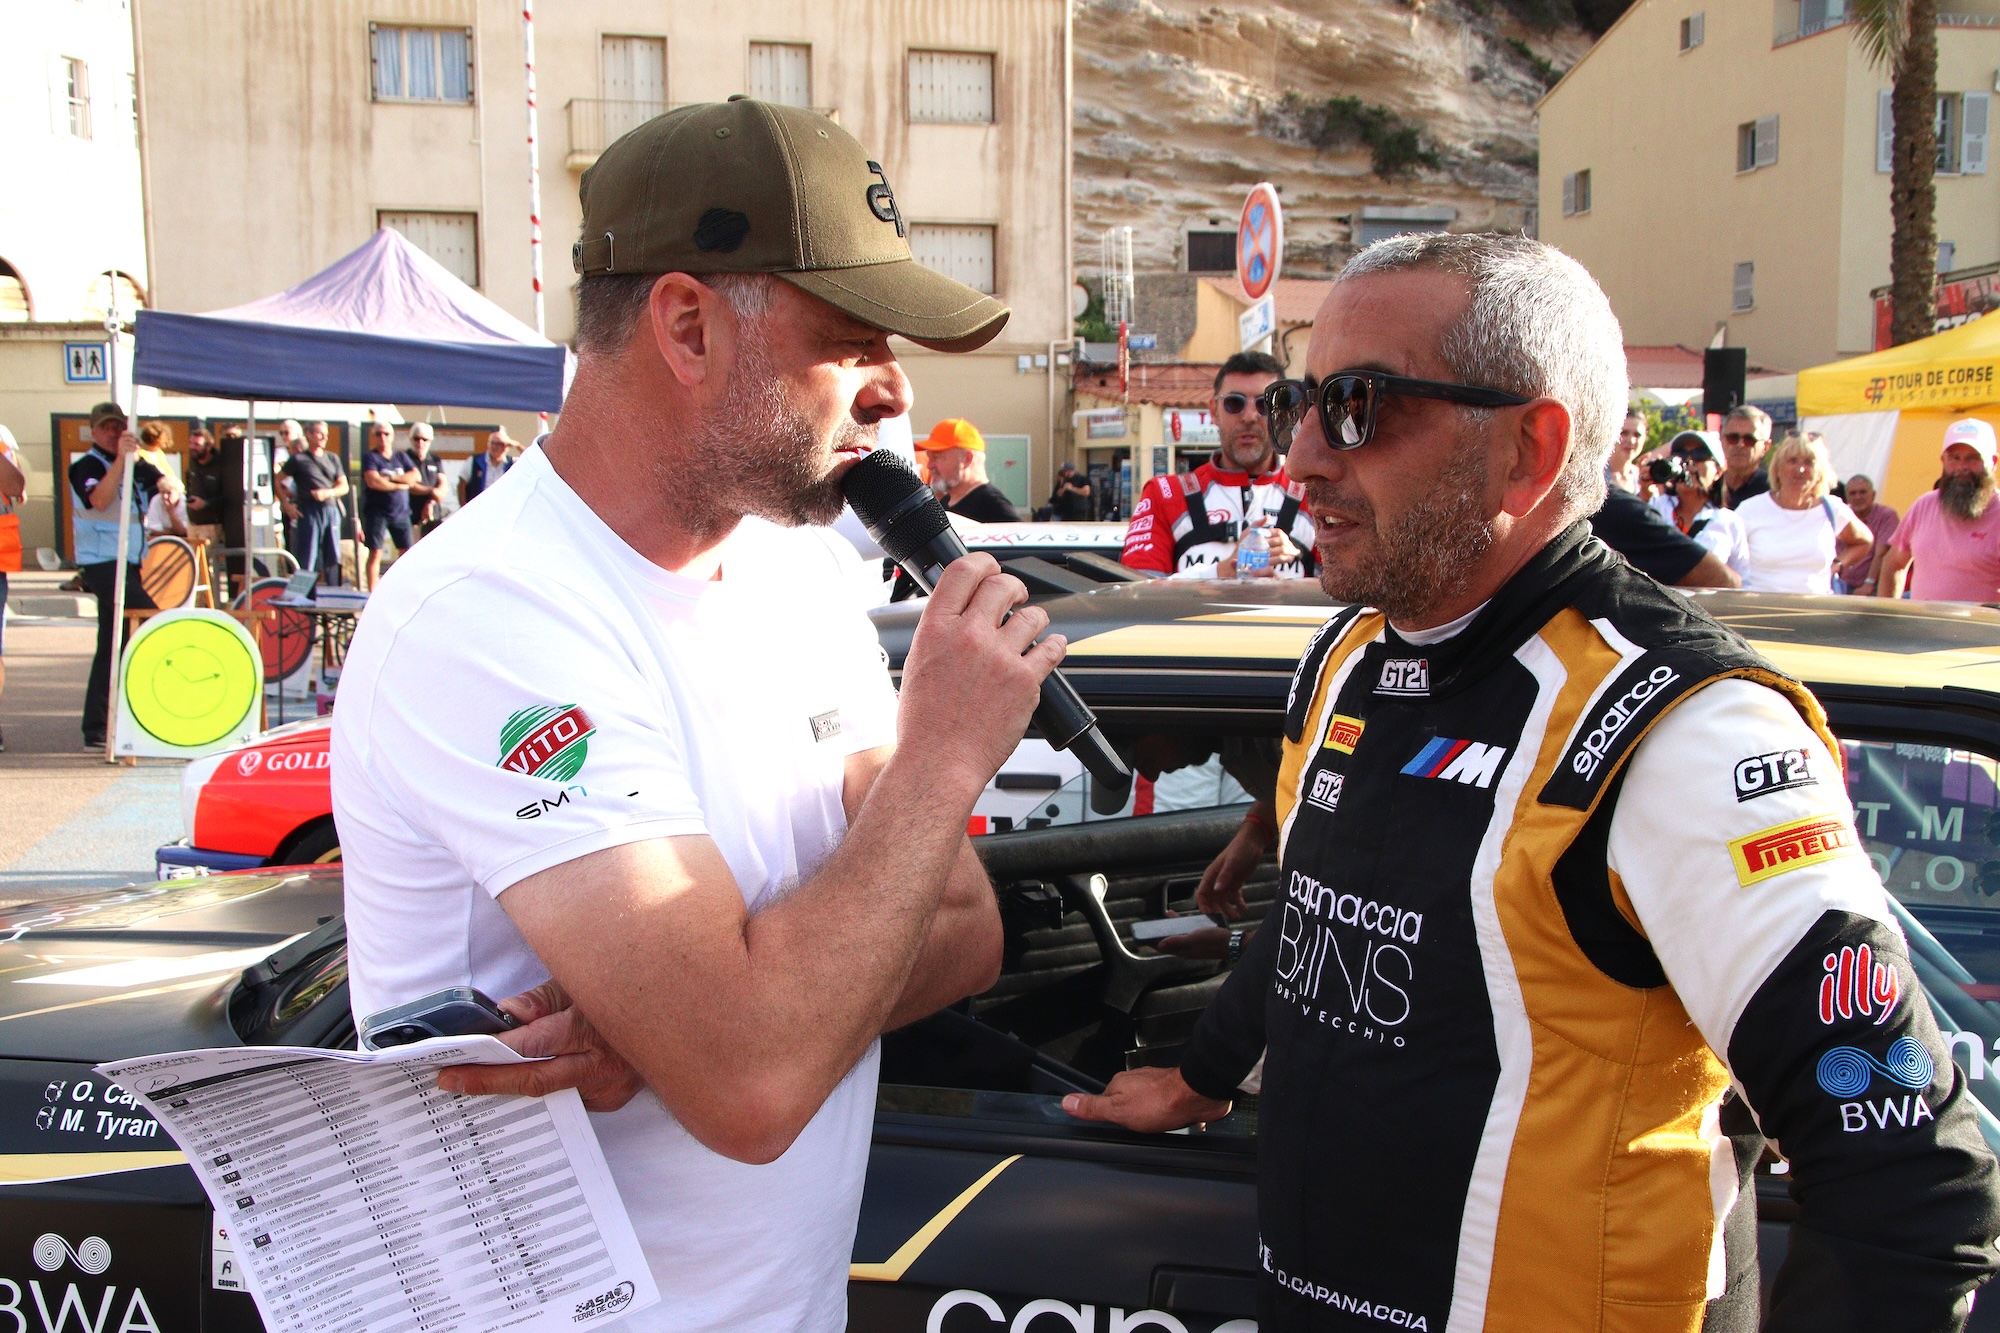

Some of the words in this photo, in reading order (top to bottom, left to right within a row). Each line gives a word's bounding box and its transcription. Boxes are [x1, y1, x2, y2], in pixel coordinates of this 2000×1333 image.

[1888, 373, 1922, 390] TOUR
[1927, 371, 1943, 386] DE
[1948, 366, 1993, 384] CORSE
[1378, 659, 1430, 691] GT2i
[1329, 721, 1361, 749] PIRELL
[1572, 664, 1676, 779] sparco
[1818, 942, 1900, 1026] illy
[71, 1080, 95, 1103] O.
[59, 1108, 86, 1132] M.
[95, 1110, 158, 1140] Tyran
[1839, 1094, 1935, 1133] BWA
[518, 1245, 534, 1254] Porsche
[525, 1263, 542, 1272] Porsche
[533, 1283, 547, 1291] Lancia
[570, 1308, 596, 1323] TERRE
[595, 1303, 607, 1313] DE
[605, 1292, 631, 1309] CORSE
